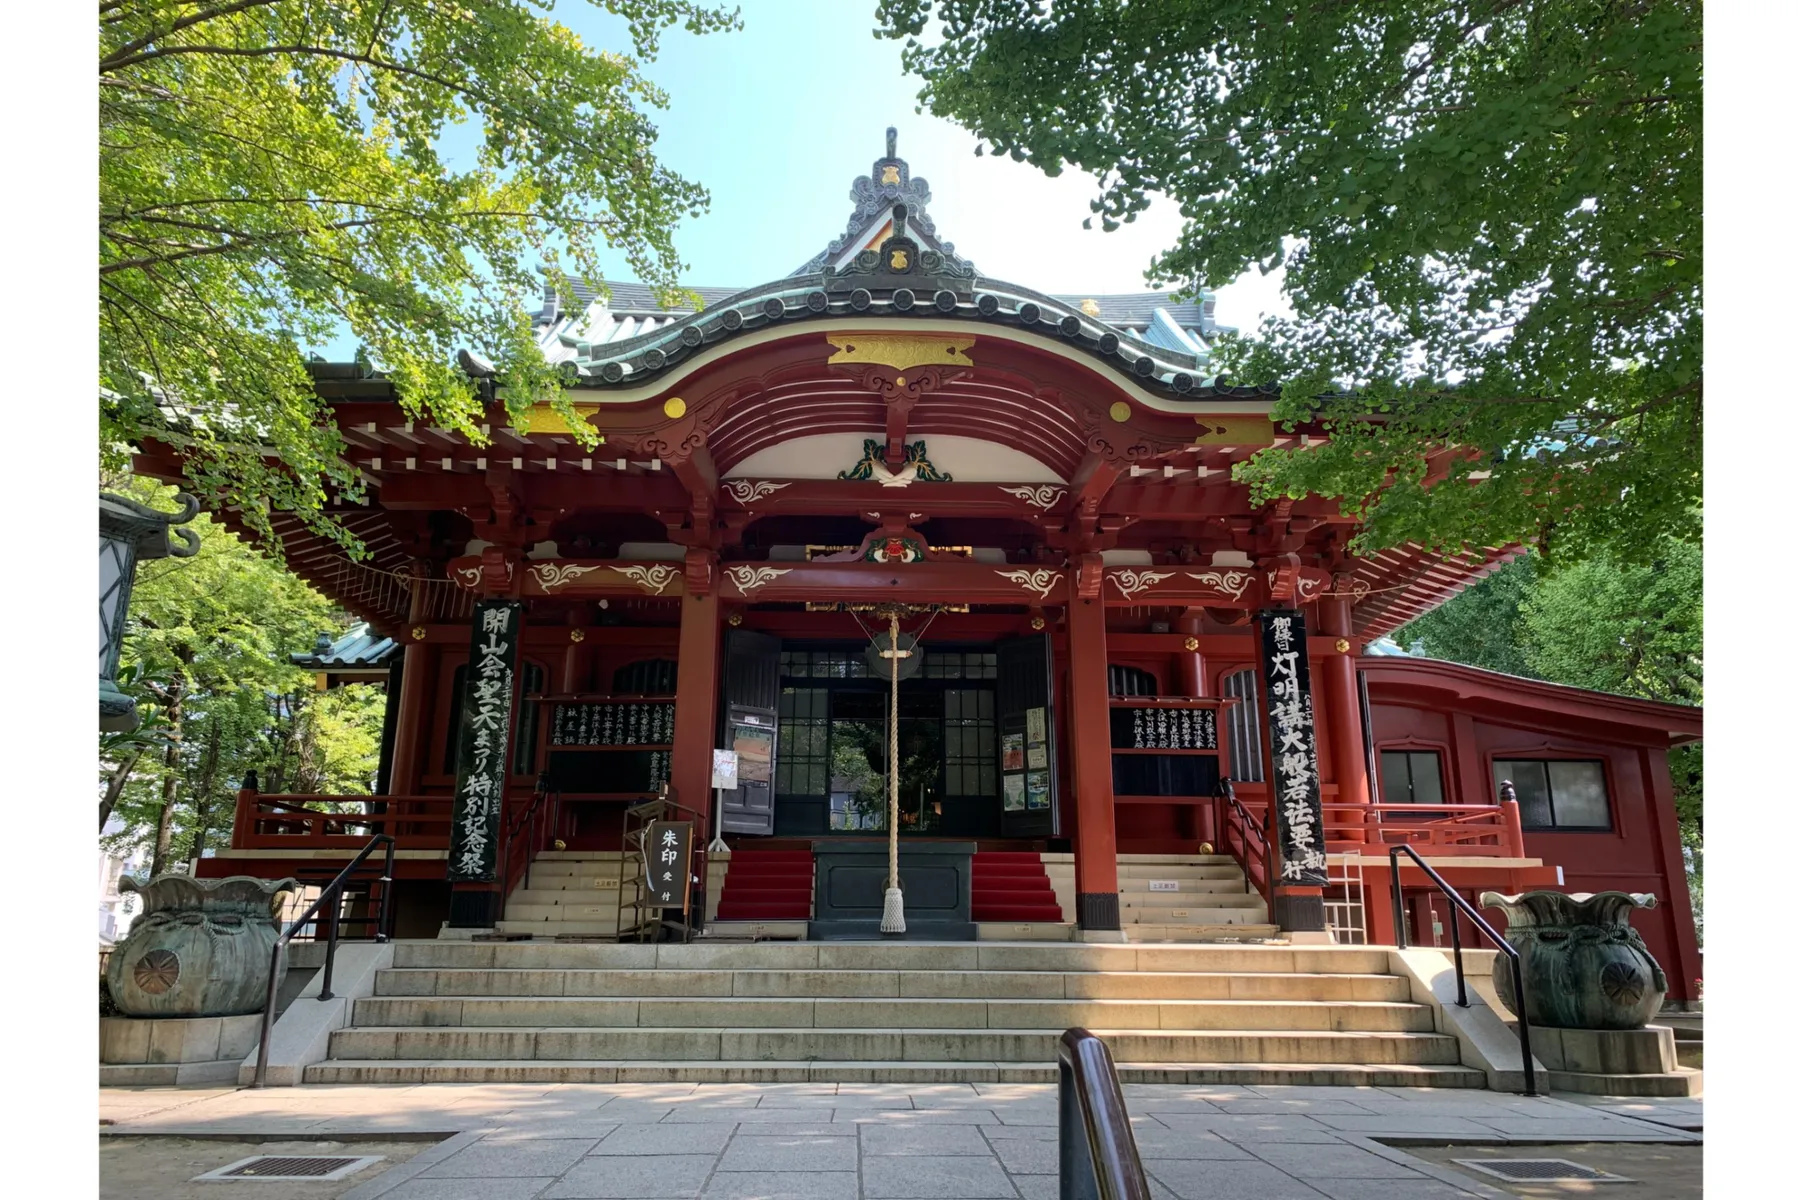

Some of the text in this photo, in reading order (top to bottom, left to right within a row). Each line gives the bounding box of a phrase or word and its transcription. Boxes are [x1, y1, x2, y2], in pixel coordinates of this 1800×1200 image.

[457, 608, 511, 874] 開山会聖天まつり特別記念祭
[661, 829, 679, 902] 朱印受付
